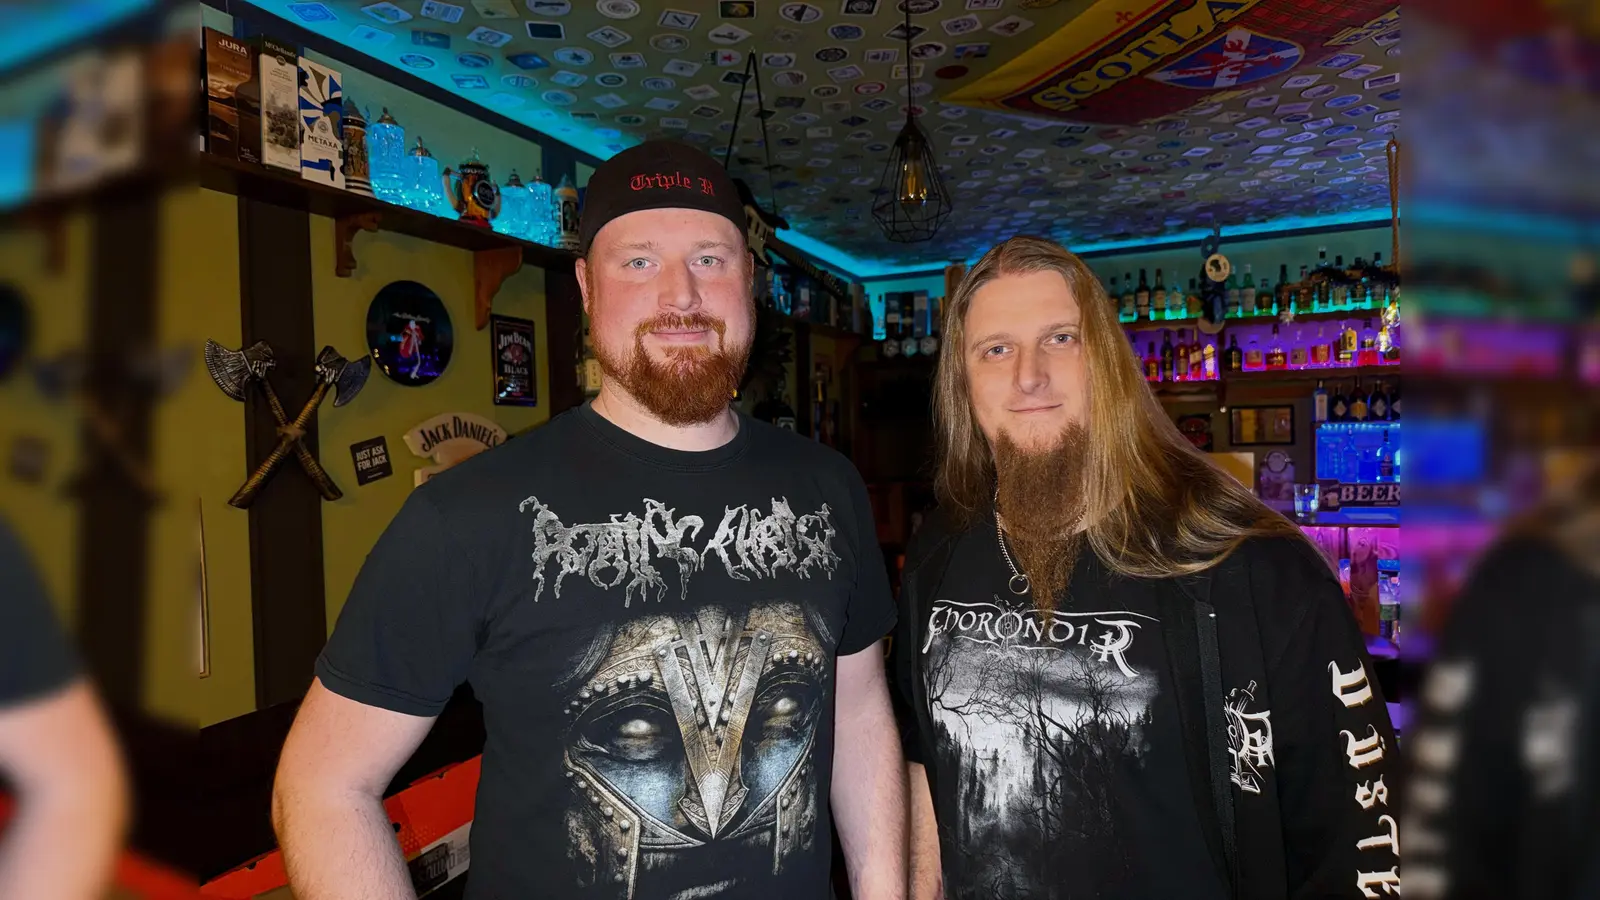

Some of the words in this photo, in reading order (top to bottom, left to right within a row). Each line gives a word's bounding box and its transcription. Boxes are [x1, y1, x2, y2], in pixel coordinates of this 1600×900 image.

[218, 38, 248, 56] JURA
[308, 134, 339, 150] METAXA
[629, 171, 693, 191] Triple
[498, 333, 514, 350] JIM
[513, 331, 532, 353] BEAM
[504, 364, 529, 376] BLACK
[420, 422, 452, 452] JACK
[453, 416, 499, 448] DANIEL'S
[356, 448, 371, 461] JUST
[372, 444, 385, 456] ASK
[357, 459, 371, 471] FOR
[372, 454, 388, 467] JACK
[1339, 484, 1400, 501] BEER
